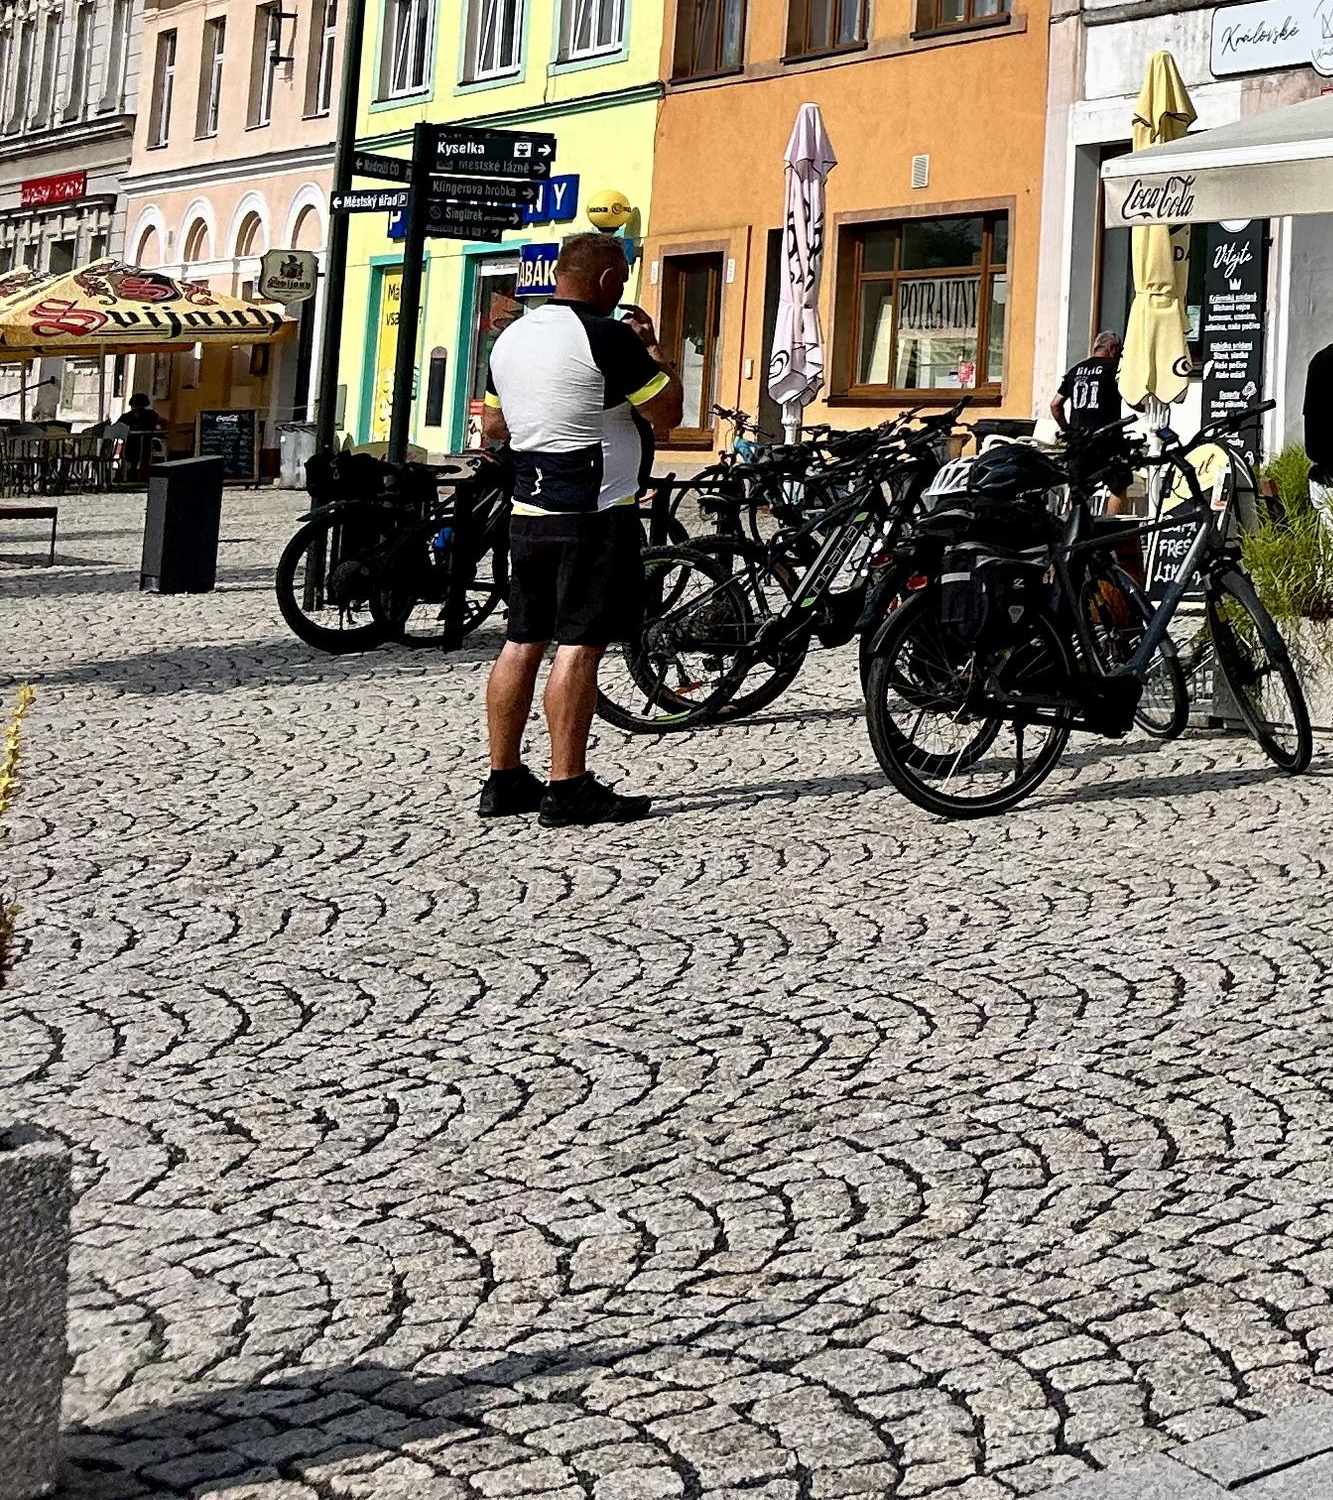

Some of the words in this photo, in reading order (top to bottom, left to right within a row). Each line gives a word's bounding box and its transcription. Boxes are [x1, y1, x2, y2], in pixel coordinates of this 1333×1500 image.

[437, 141, 485, 156] Kyselka
[433, 181, 482, 196] Klingerova
[485, 184, 516, 197] hrobka
[1121, 175, 1196, 220] Coca-Cola
[28, 297, 284, 339] Svijany
[1072, 380, 1099, 409] 01
